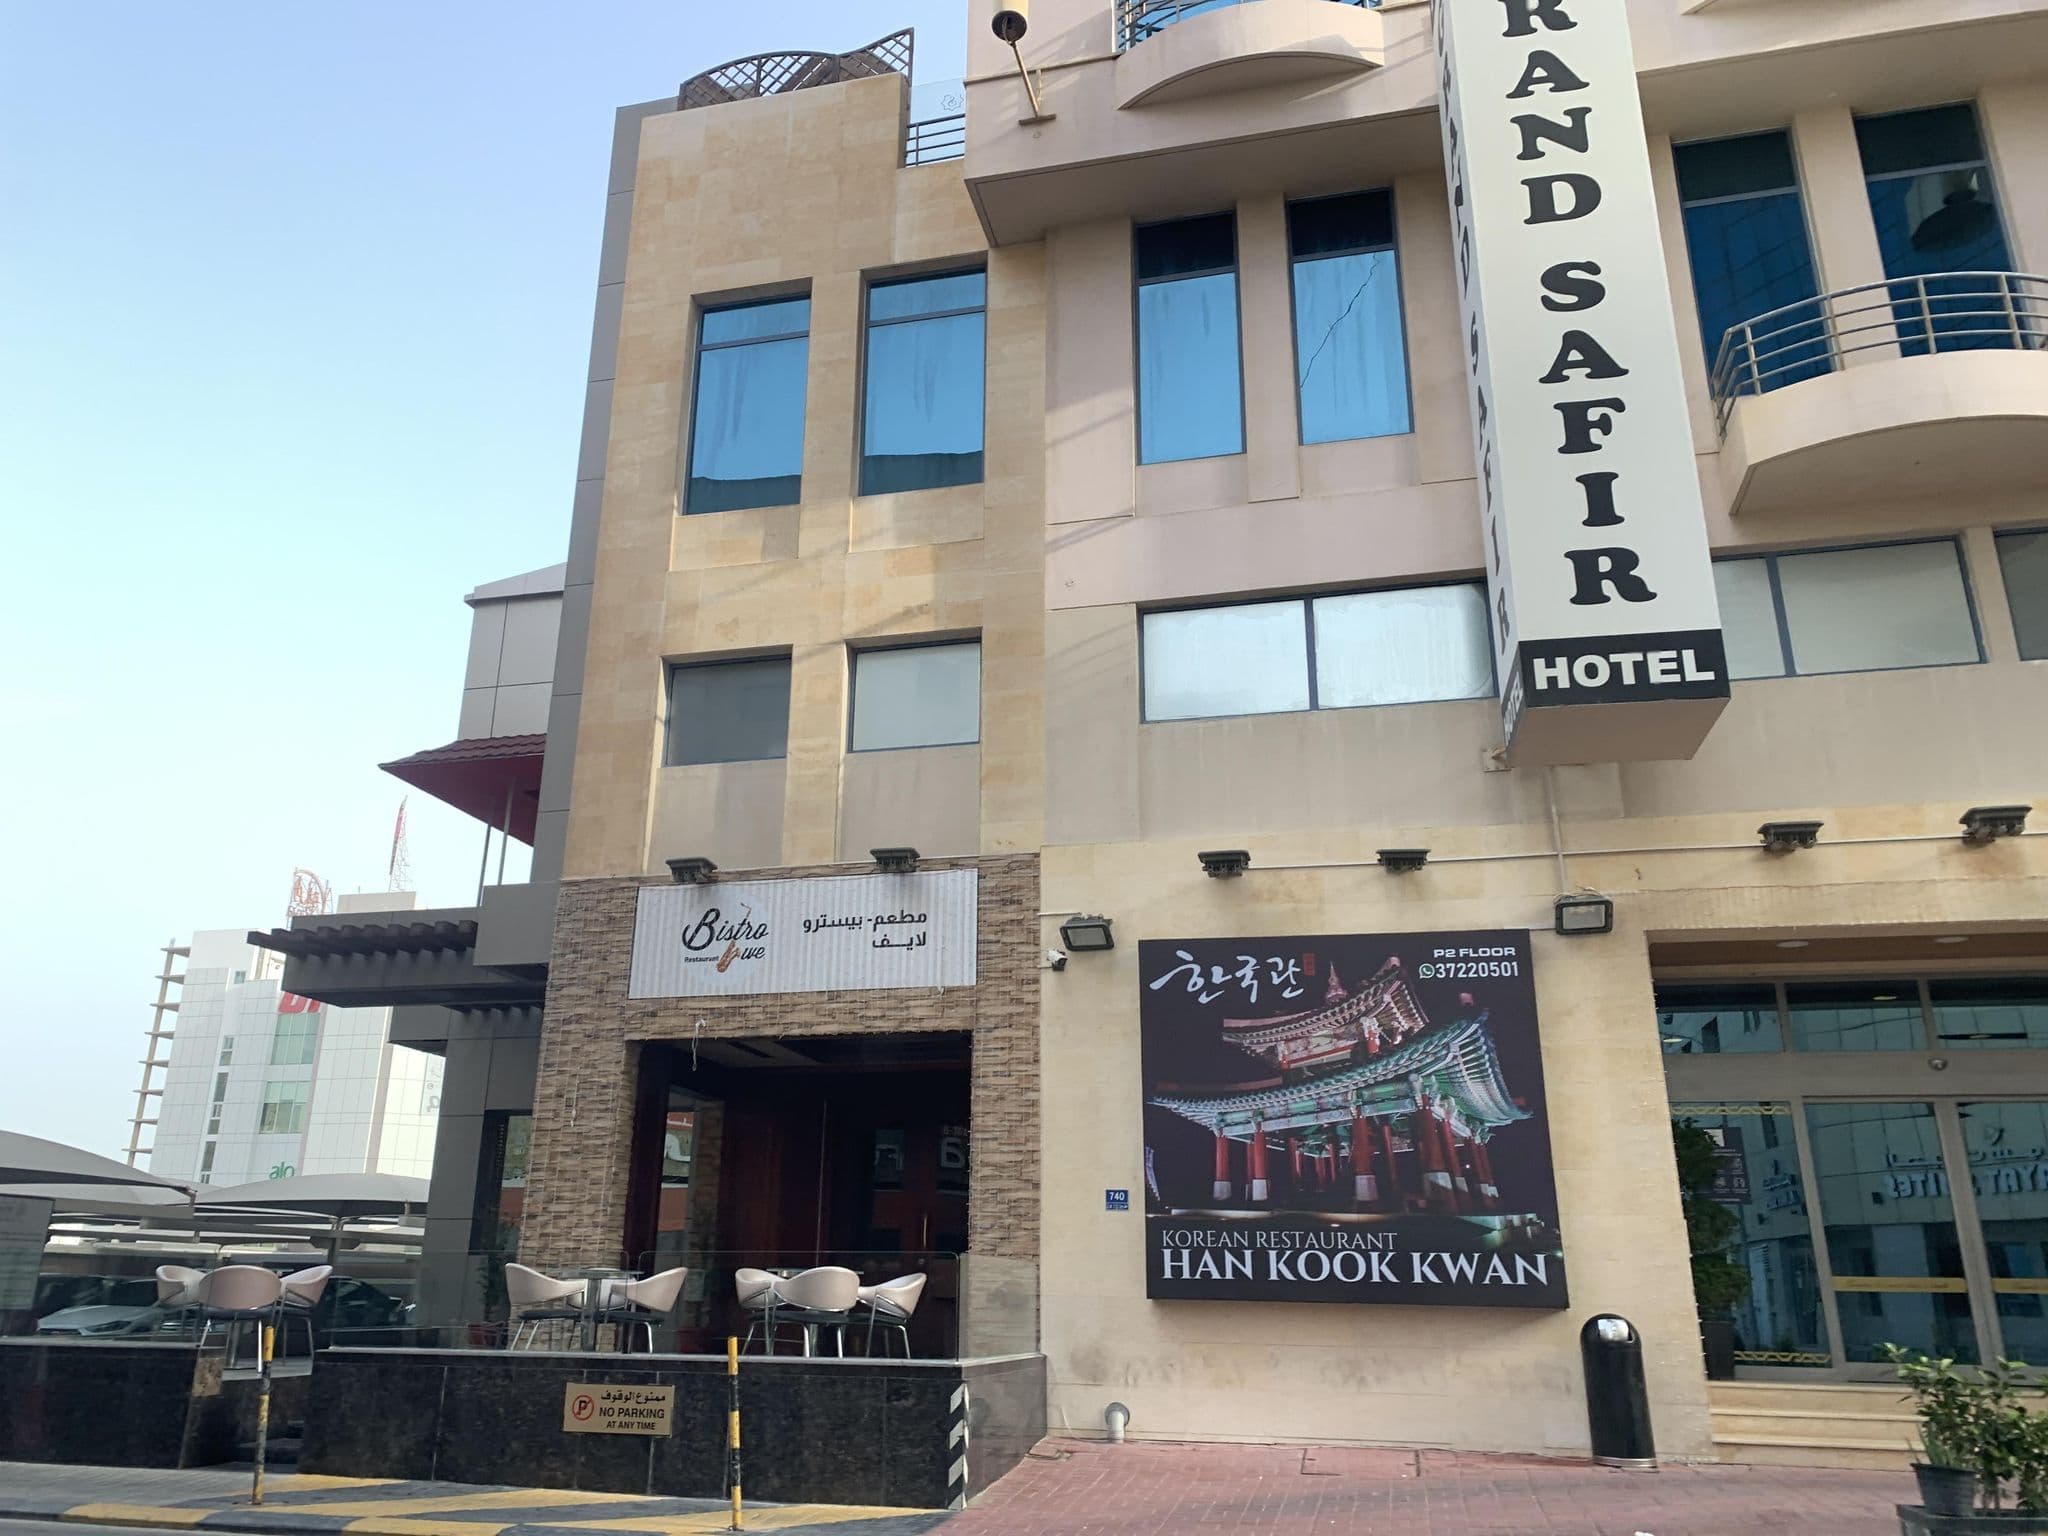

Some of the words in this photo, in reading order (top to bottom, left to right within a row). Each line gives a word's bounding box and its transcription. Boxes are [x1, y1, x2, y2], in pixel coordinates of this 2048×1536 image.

[1538, 260, 1658, 606] SAFIR
[1532, 648, 1715, 690] HOTEL
[682, 908, 769, 951] Bistro
[803, 914, 863, 933] بيسترو
[872, 931, 926, 951] لايف
[1433, 949, 1456, 958] P2
[1459, 947, 1516, 957] FLOOR
[1149, 950, 1305, 1004] 한국관
[1436, 961, 1519, 978] 37220501
[1109, 1191, 1125, 1201] 740
[1162, 1230, 1249, 1248] KOREAN
[1256, 1231, 1398, 1250] RESTAURANT
[1162, 1249, 1254, 1280] HAN
[1267, 1250, 1400, 1283] KOOK
[1410, 1252, 1549, 1286] KWAN
[635, 1391, 666, 1404] ممنوع
[599, 1406, 615, 1418] NO
[617, 1407, 665, 1419] PARKING
[606, 1420, 617, 1429] AT
[618, 1421, 635, 1429] ANY
[636, 1422, 657, 1430] TIME
